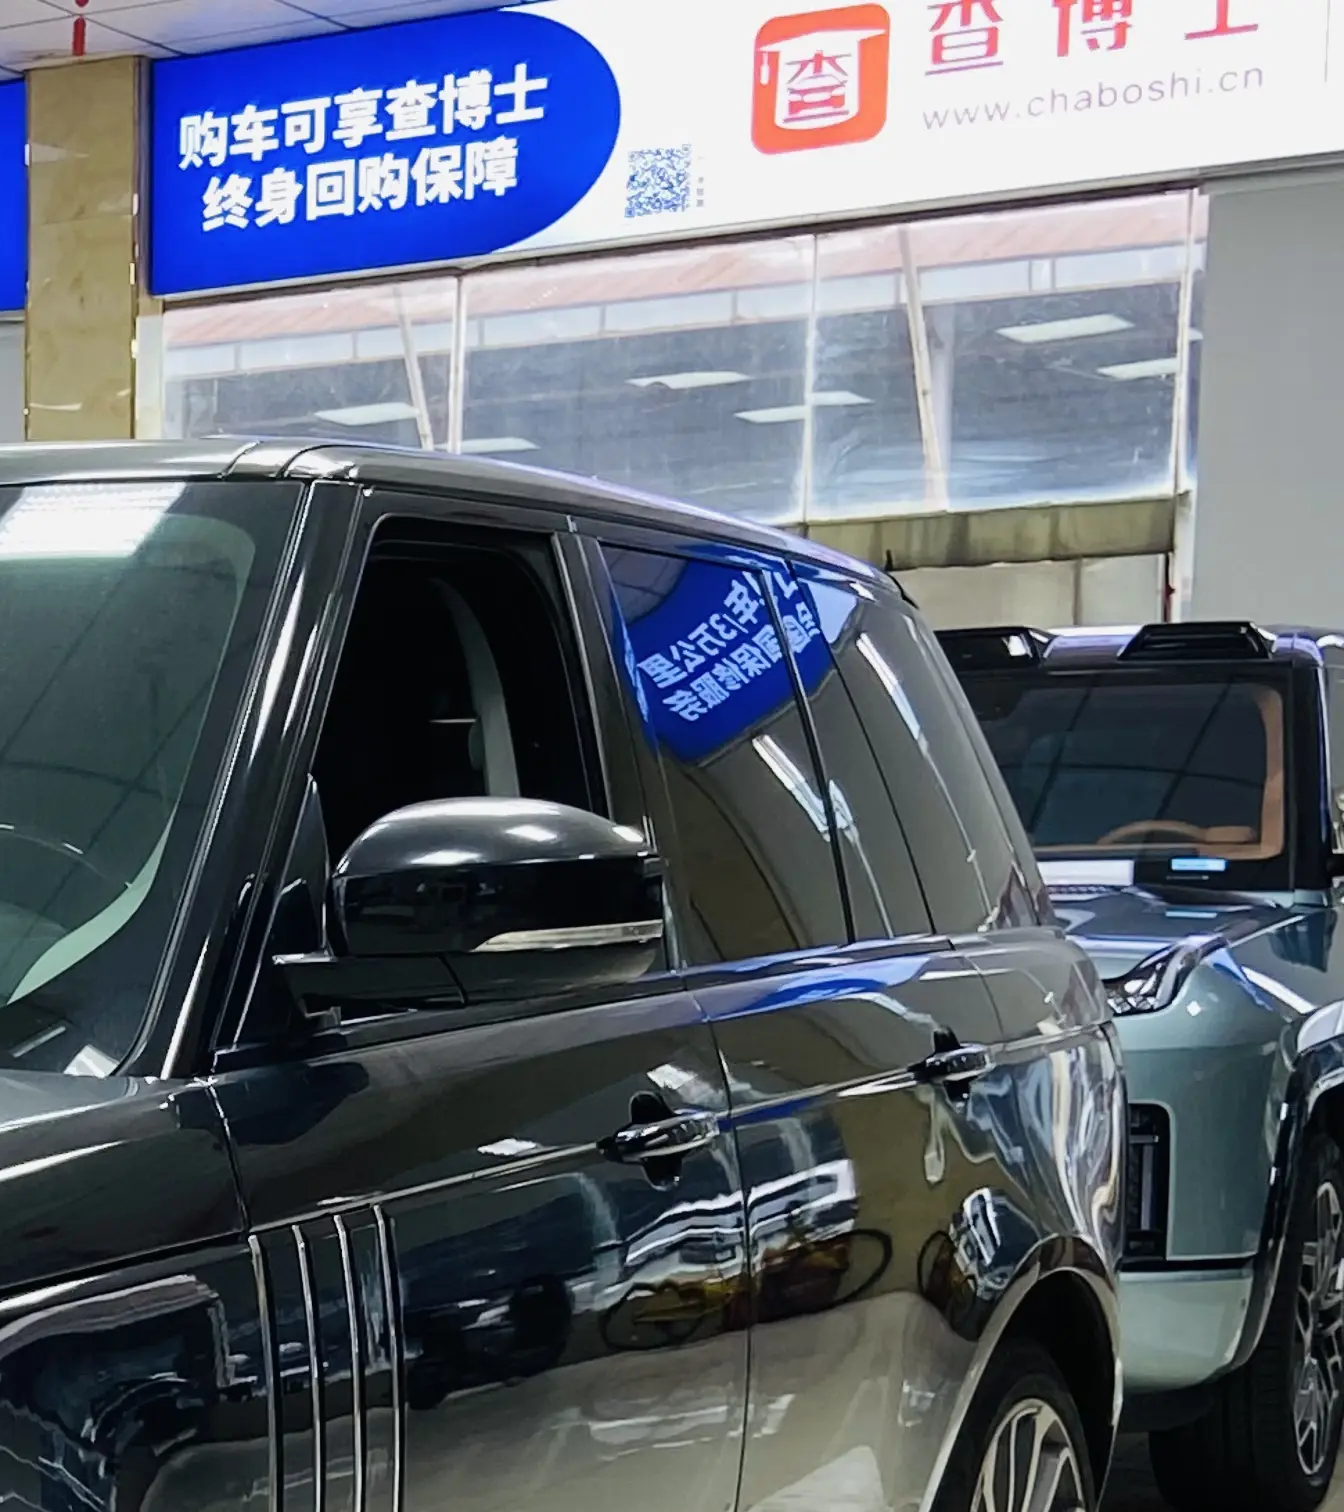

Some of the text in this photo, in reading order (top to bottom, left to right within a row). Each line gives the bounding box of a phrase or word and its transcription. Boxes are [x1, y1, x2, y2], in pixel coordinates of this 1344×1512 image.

[178, 62, 549, 170] 购车可享查博士
[923, 66, 1264, 131] www.chaboshi.cn
[201, 135, 519, 232] 终身回购保障
